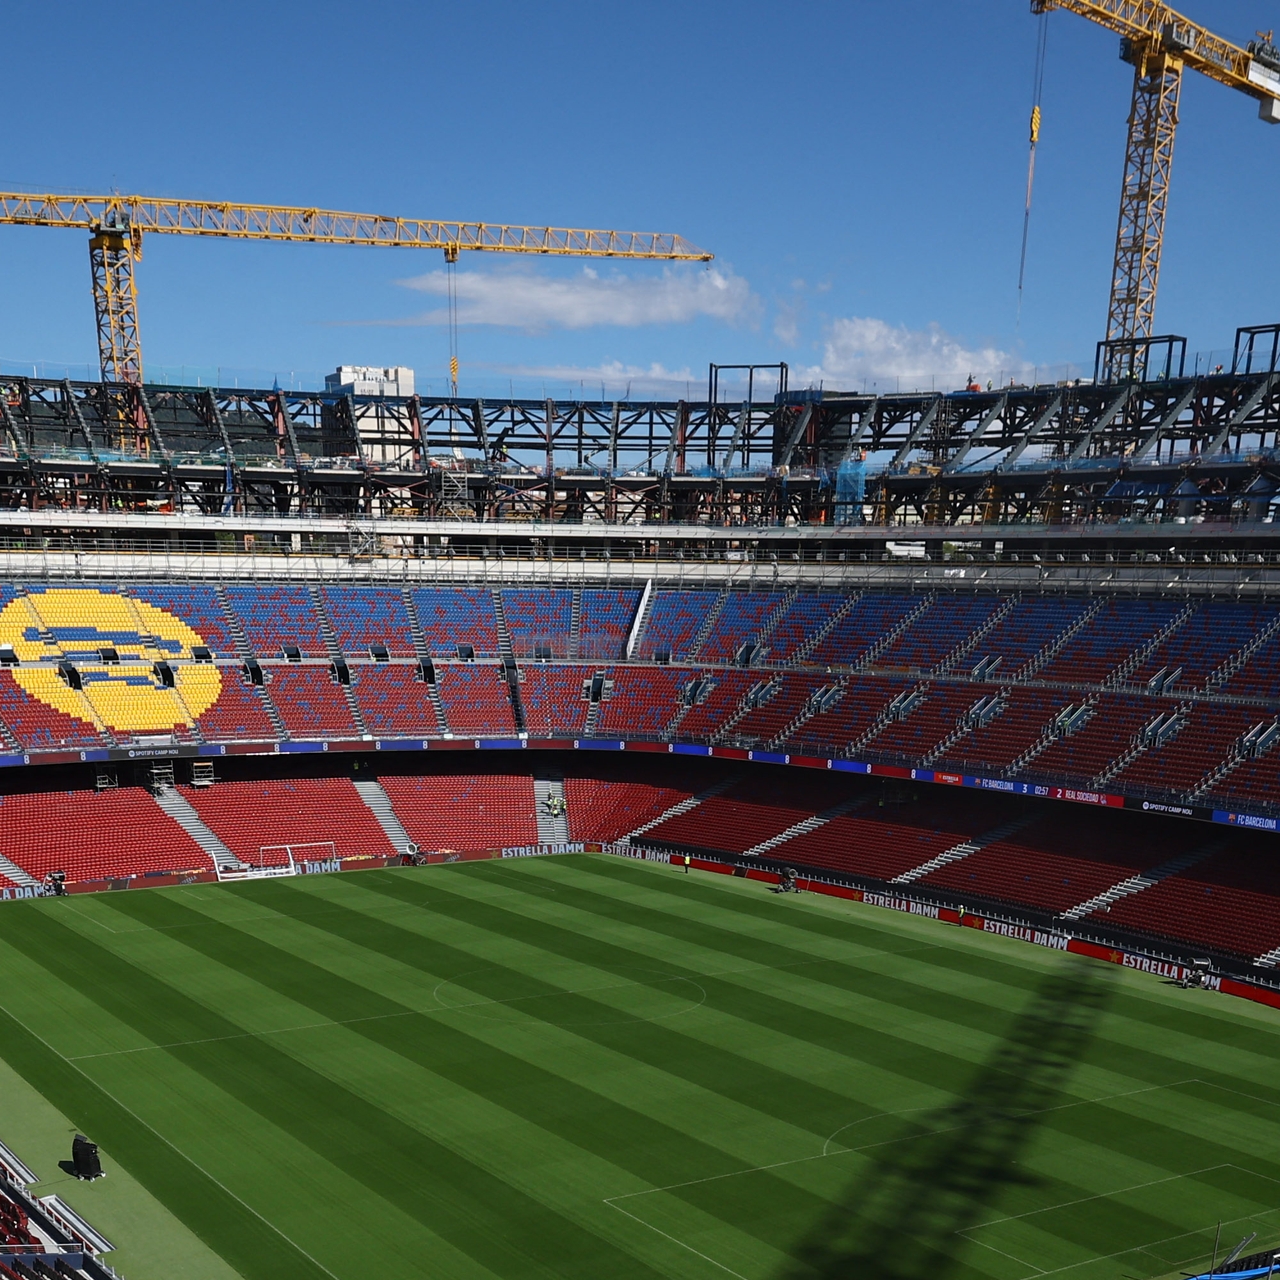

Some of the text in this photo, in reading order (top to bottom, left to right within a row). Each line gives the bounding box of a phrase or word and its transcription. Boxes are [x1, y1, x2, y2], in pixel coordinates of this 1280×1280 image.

[274, 743, 280, 752] 8
[323, 742, 328, 751] 8
[375, 741, 381, 750] 8
[422, 740, 428, 749] 8
[474, 740, 480, 749] 8
[521, 739, 527, 749] 8
[573, 739, 579, 749] 8
[619, 740, 625, 750] 8
[668, 743, 673, 753] 8
[220, 745, 226, 755] 8
[708, 746, 713, 756] 8
[748, 750, 753, 760] 8
[24, 754, 30, 764] 8
[80, 751, 86, 761] 8
[784, 754, 790, 764] 8
[827, 759, 832, 769] 8
[866, 764, 872, 774] 8
[910, 768, 916, 779] 8
[982, 778, 1014, 791] FC BARCELONA
[1022, 784, 1028, 793] 3
[1034, 785, 1049, 796] 02:57
[1056, 788, 1062, 798] 2
[1065, 790, 1099, 802] REAL SOCIEDAD
[1149, 803, 1193, 815] SPOTIFY CAMP NOU
[1237, 814, 1276, 830] FC BARCELONA
[501, 843, 585, 858] ESTRELLA DAMM
[602, 844, 670, 864] ESTRELLA DAMM
[306, 861, 341, 874] DAMM
[862, 892, 939, 919] ESTRELLA DAMM
[983, 920, 1069, 951] ESTRELLA DAMM
[1122, 952, 1178, 979] ESTRELLA
